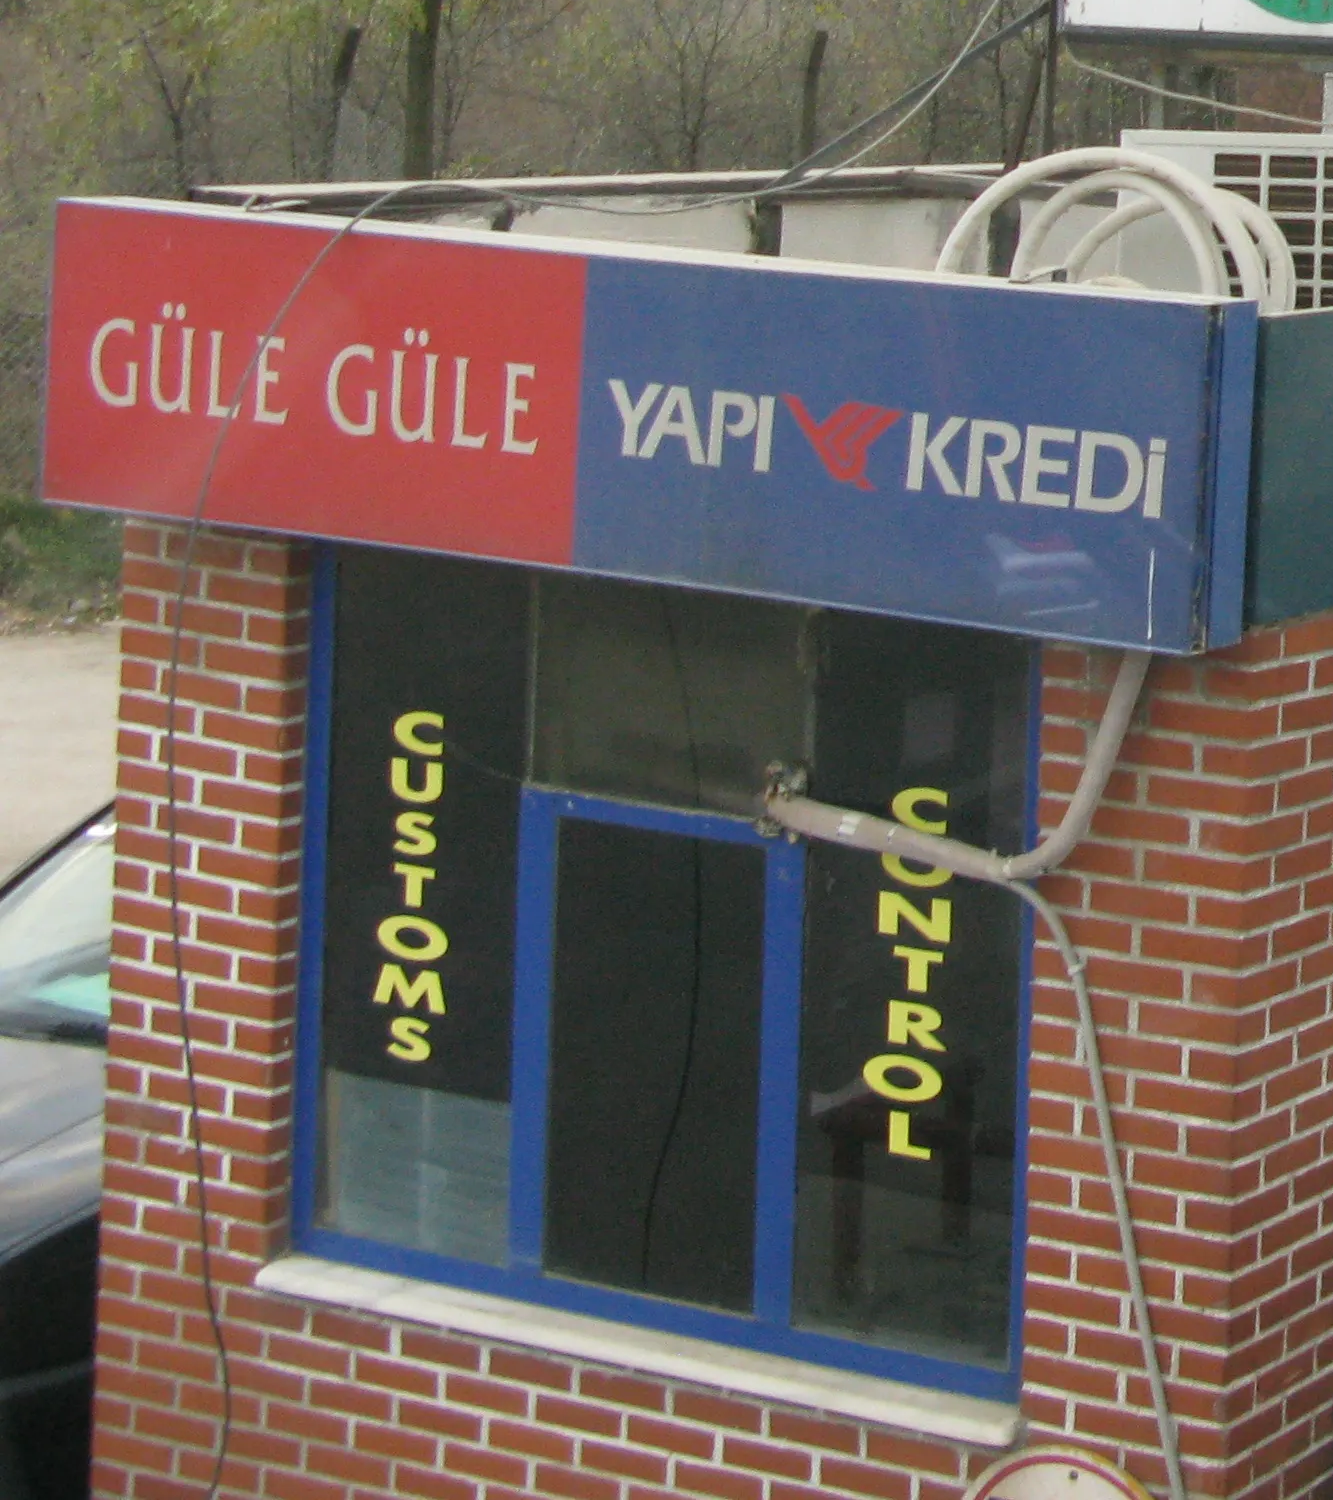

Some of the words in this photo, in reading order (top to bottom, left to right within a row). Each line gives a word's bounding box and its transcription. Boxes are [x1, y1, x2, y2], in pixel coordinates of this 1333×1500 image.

[89, 301, 292, 426] GÜLE
[326, 327, 541, 456] GÜLE
[607, 378, 776, 475] YAPI
[372, 710, 449, 1063] CUSTOMS
